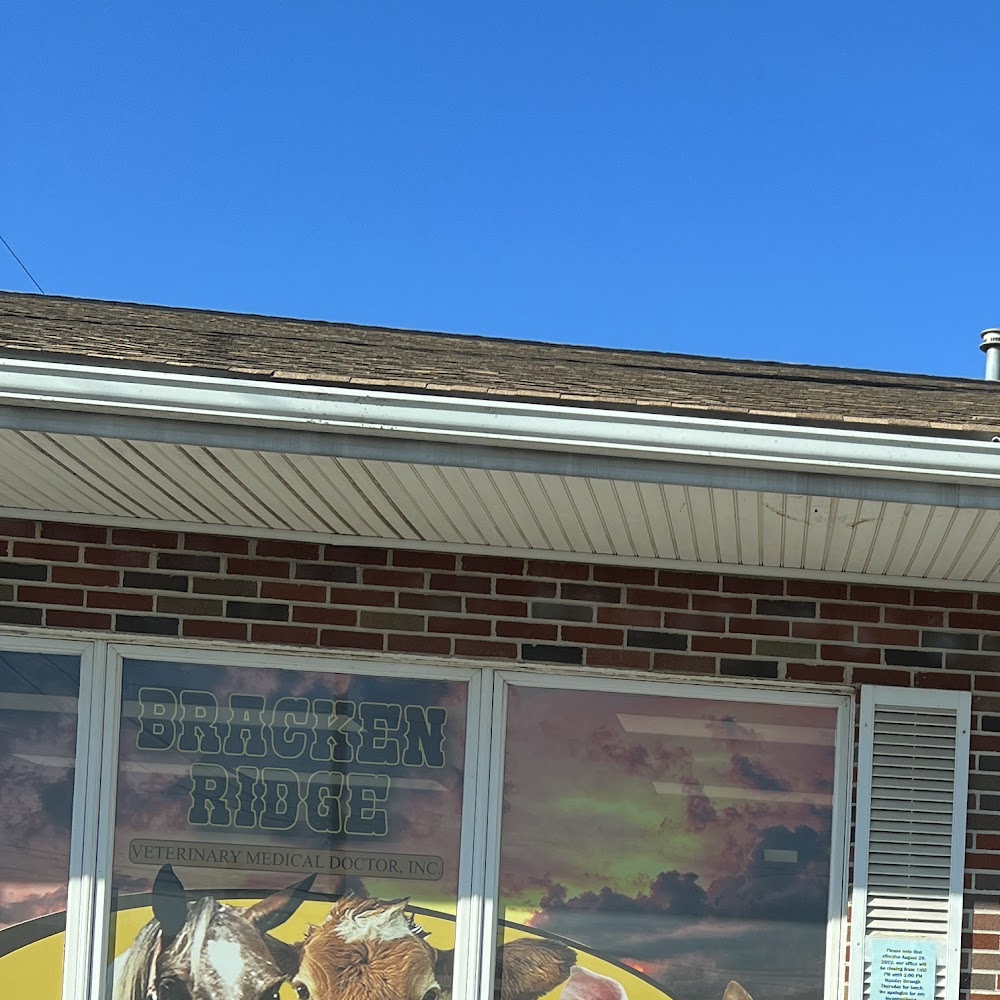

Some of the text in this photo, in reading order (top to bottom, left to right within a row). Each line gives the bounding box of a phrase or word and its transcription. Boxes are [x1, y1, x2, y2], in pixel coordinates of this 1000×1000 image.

[136, 687, 447, 768] BRACKEN
[187, 762, 391, 836] RIDGE
[131, 843, 442, 876] VETERINARY MEDICAL DOCTOR, INC.
